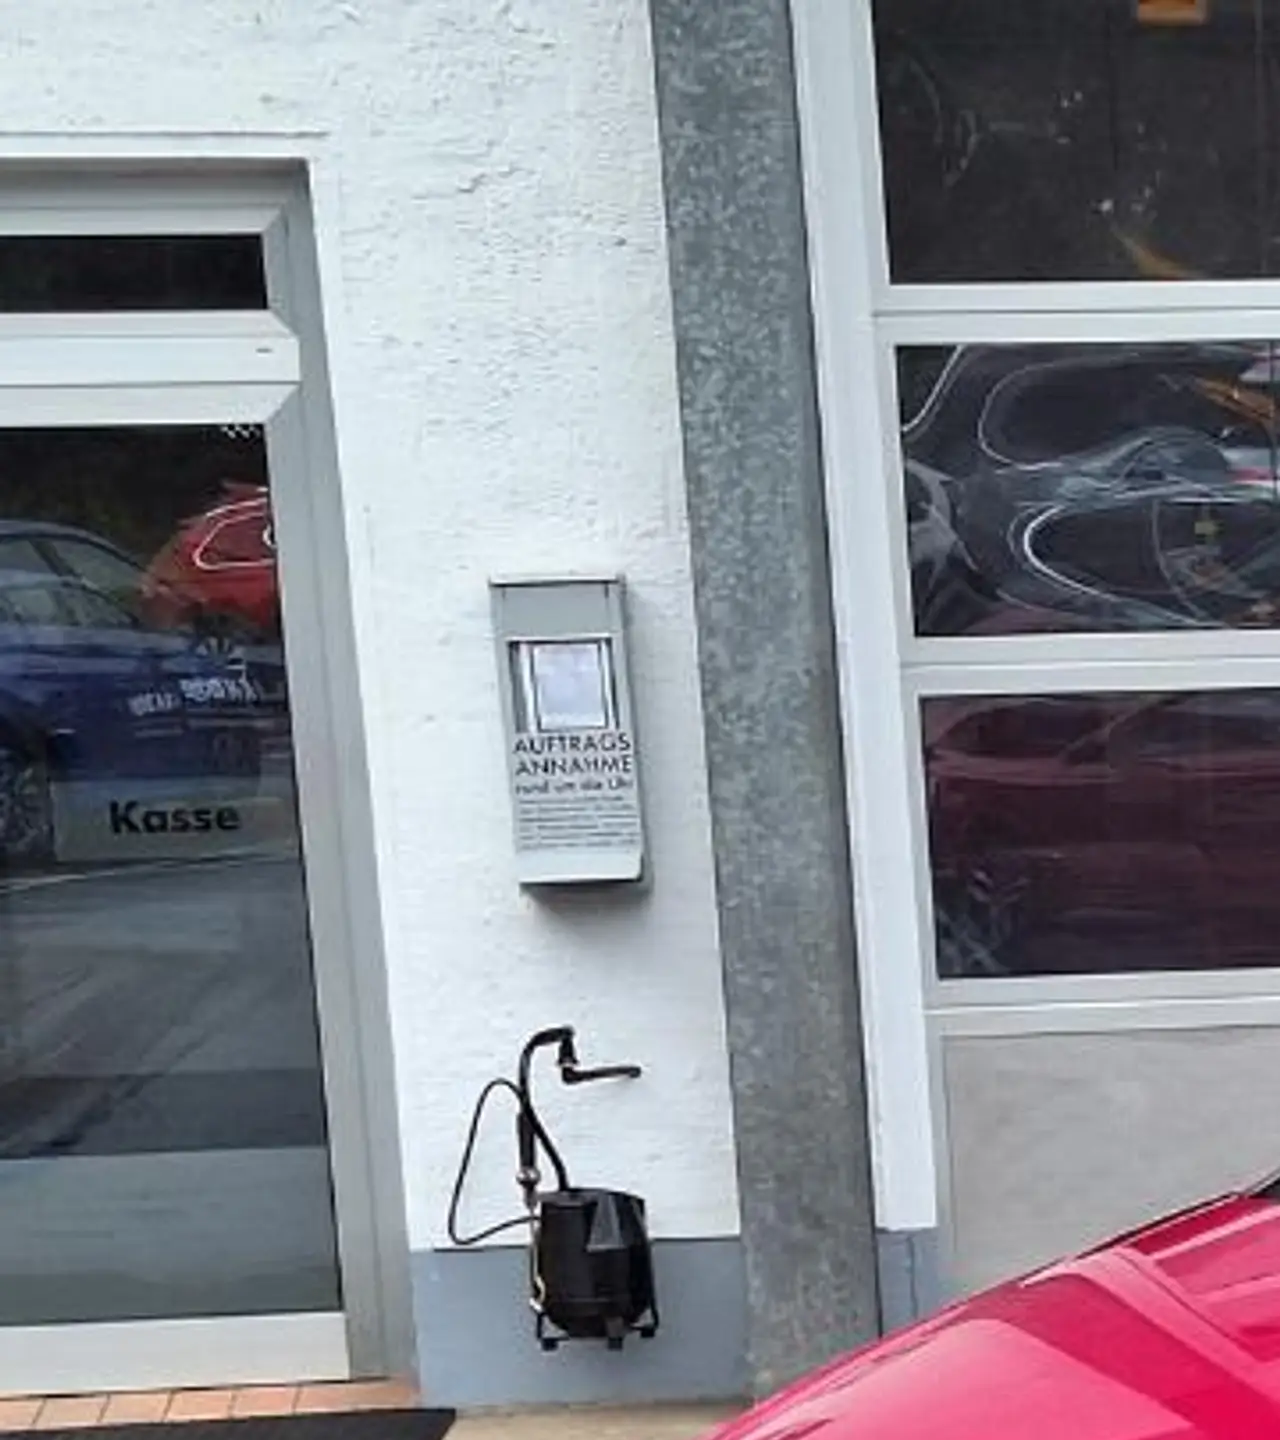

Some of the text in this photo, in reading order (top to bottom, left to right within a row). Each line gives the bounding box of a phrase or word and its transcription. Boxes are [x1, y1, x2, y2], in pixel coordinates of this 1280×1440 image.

[513, 731, 632, 754] AUFTRAGS
[515, 755, 632, 776] ANNAHME
[109, 801, 241, 834] Kasse
